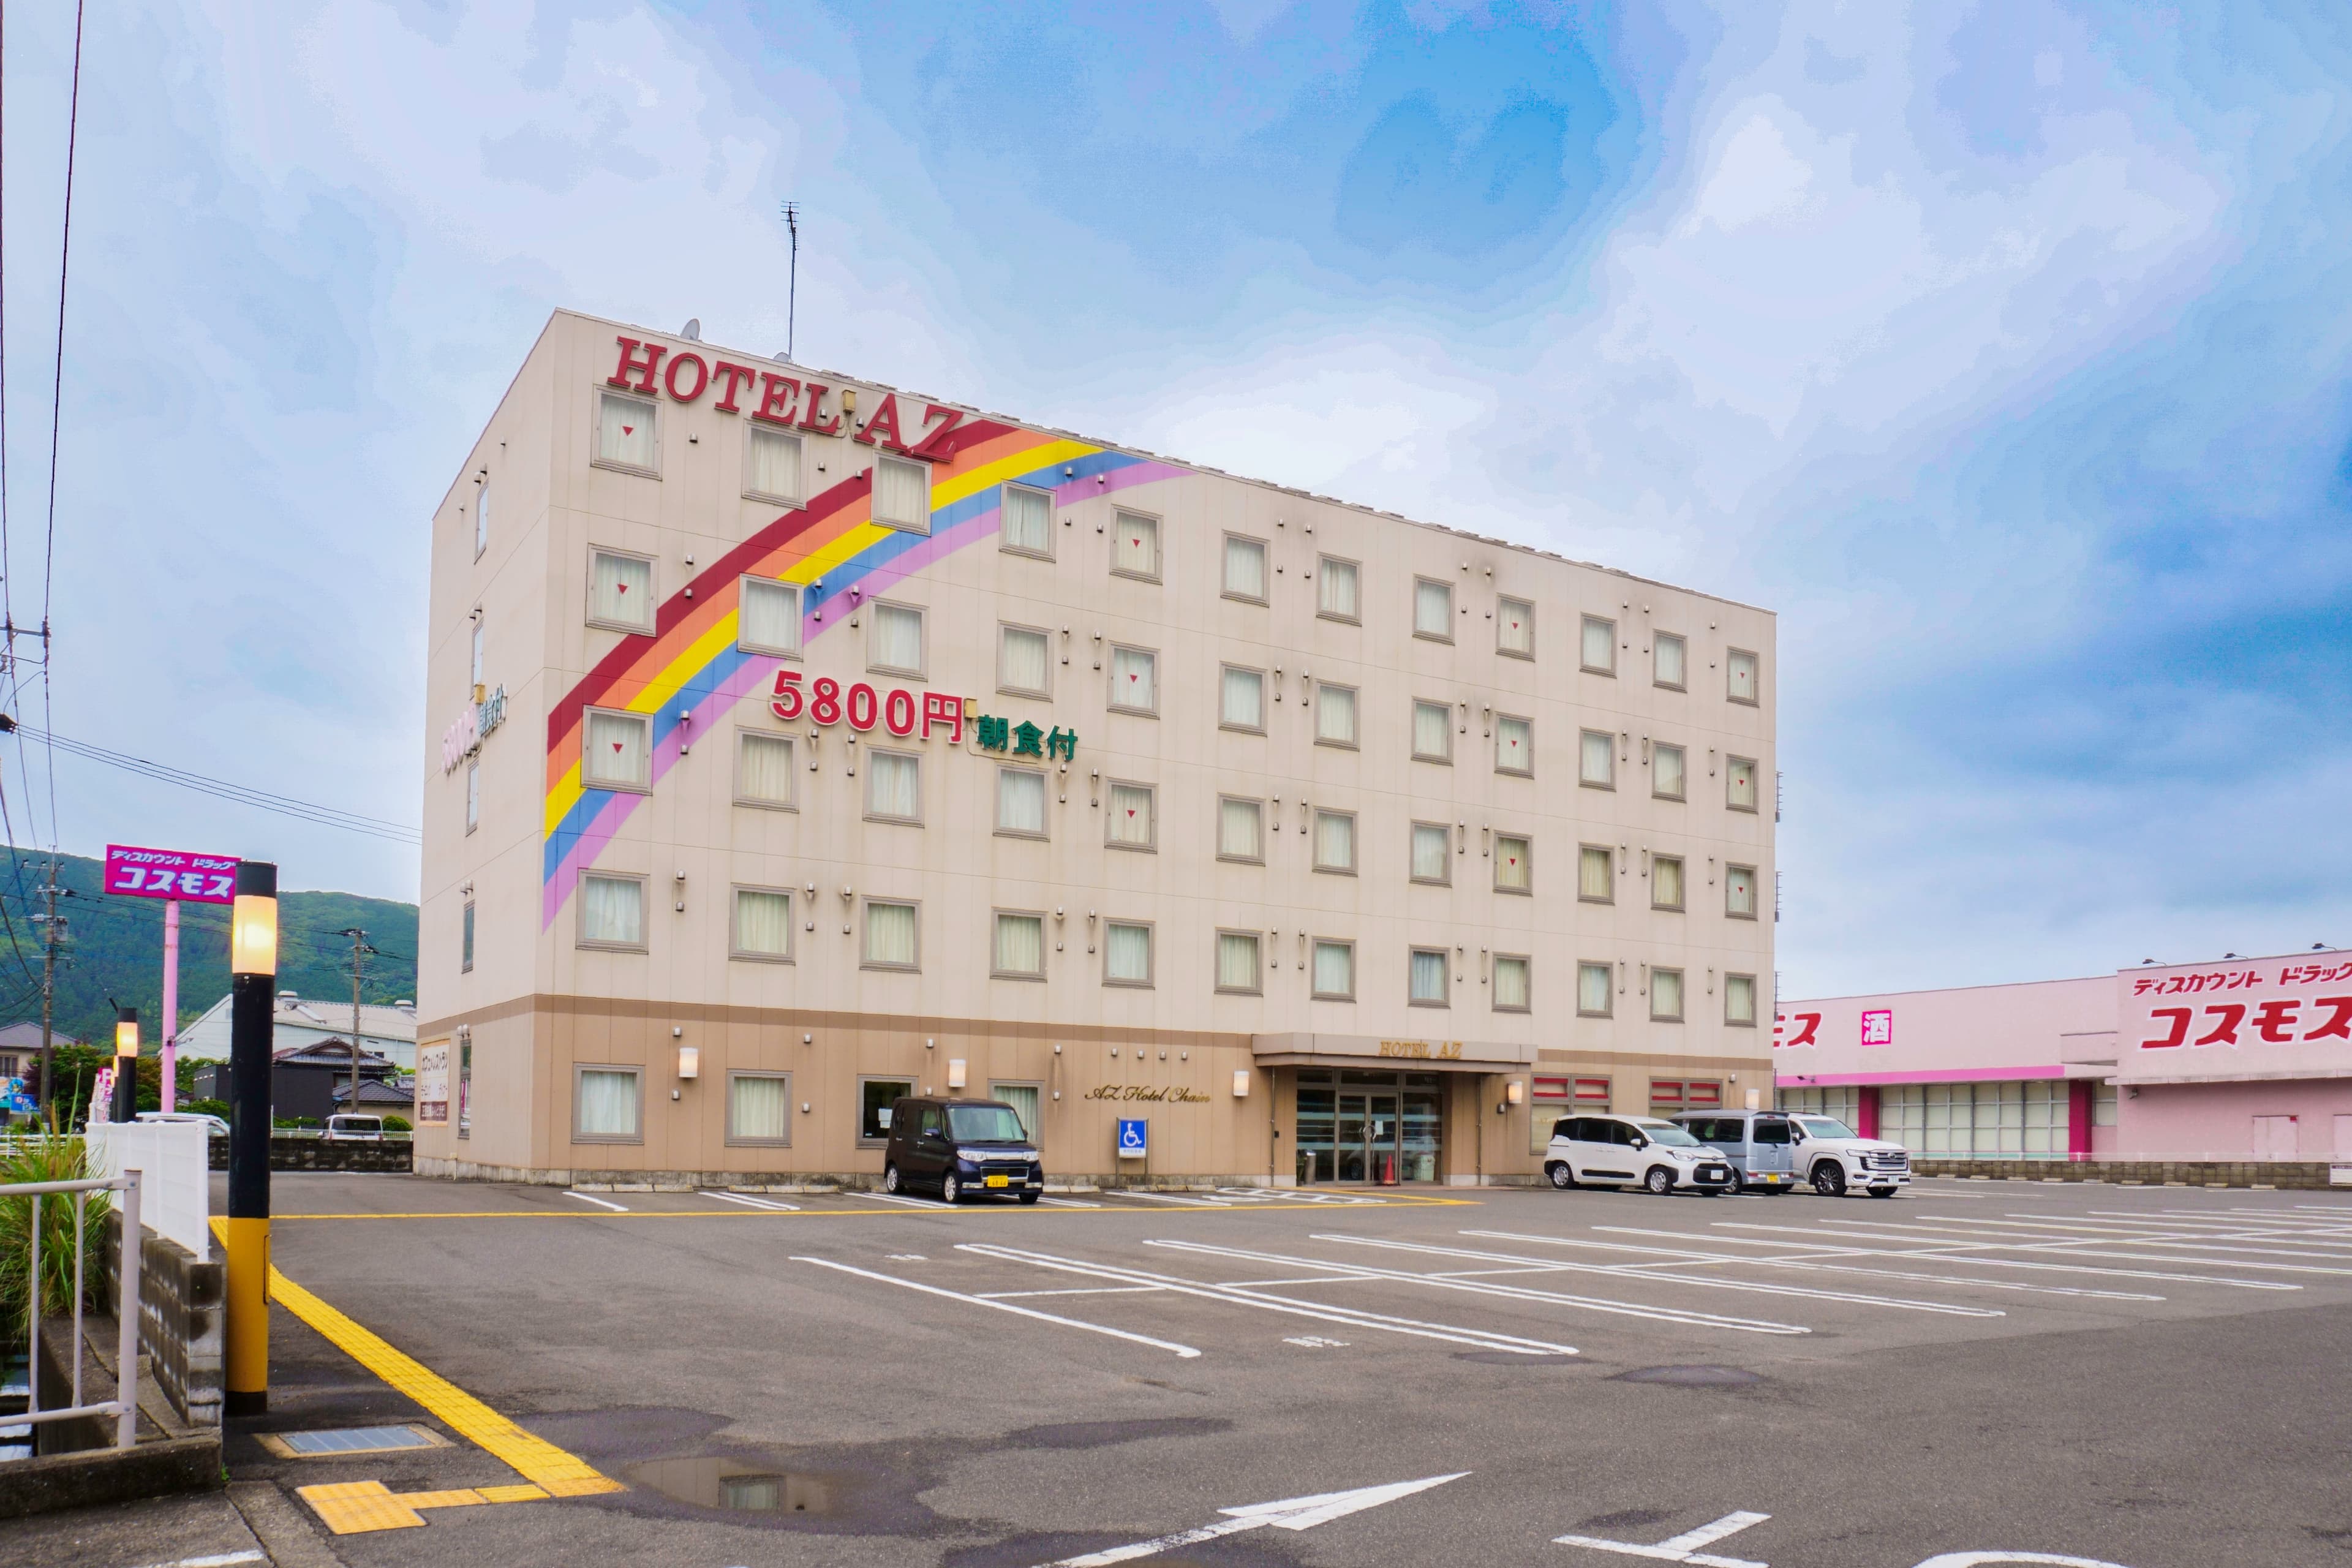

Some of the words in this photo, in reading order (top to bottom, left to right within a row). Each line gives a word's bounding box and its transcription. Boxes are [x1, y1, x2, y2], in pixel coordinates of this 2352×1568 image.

[607, 336, 840, 434] HOTEL
[854, 393, 963, 462] AZ
[769, 670, 965, 744] 5800円
[976, 714, 1078, 761] 朝食付
[111, 850, 186, 865] ディスカウント
[192, 858, 236, 870] ドラッグ
[113, 867, 234, 898] コスモス
[2133, 970, 2263, 997] ディスカウント
[1863, 1012, 1891, 1043] 酒
[2140, 995, 2352, 1049] コスモス
[1379, 1041, 1431, 1058] HOTEL
[1436, 1041, 1463, 1058] AZ
[1085, 1085, 1121, 1100] AZ
[1123, 1086, 1170, 1102] Hotel
[1168, 1087, 1211, 1102] Chain
